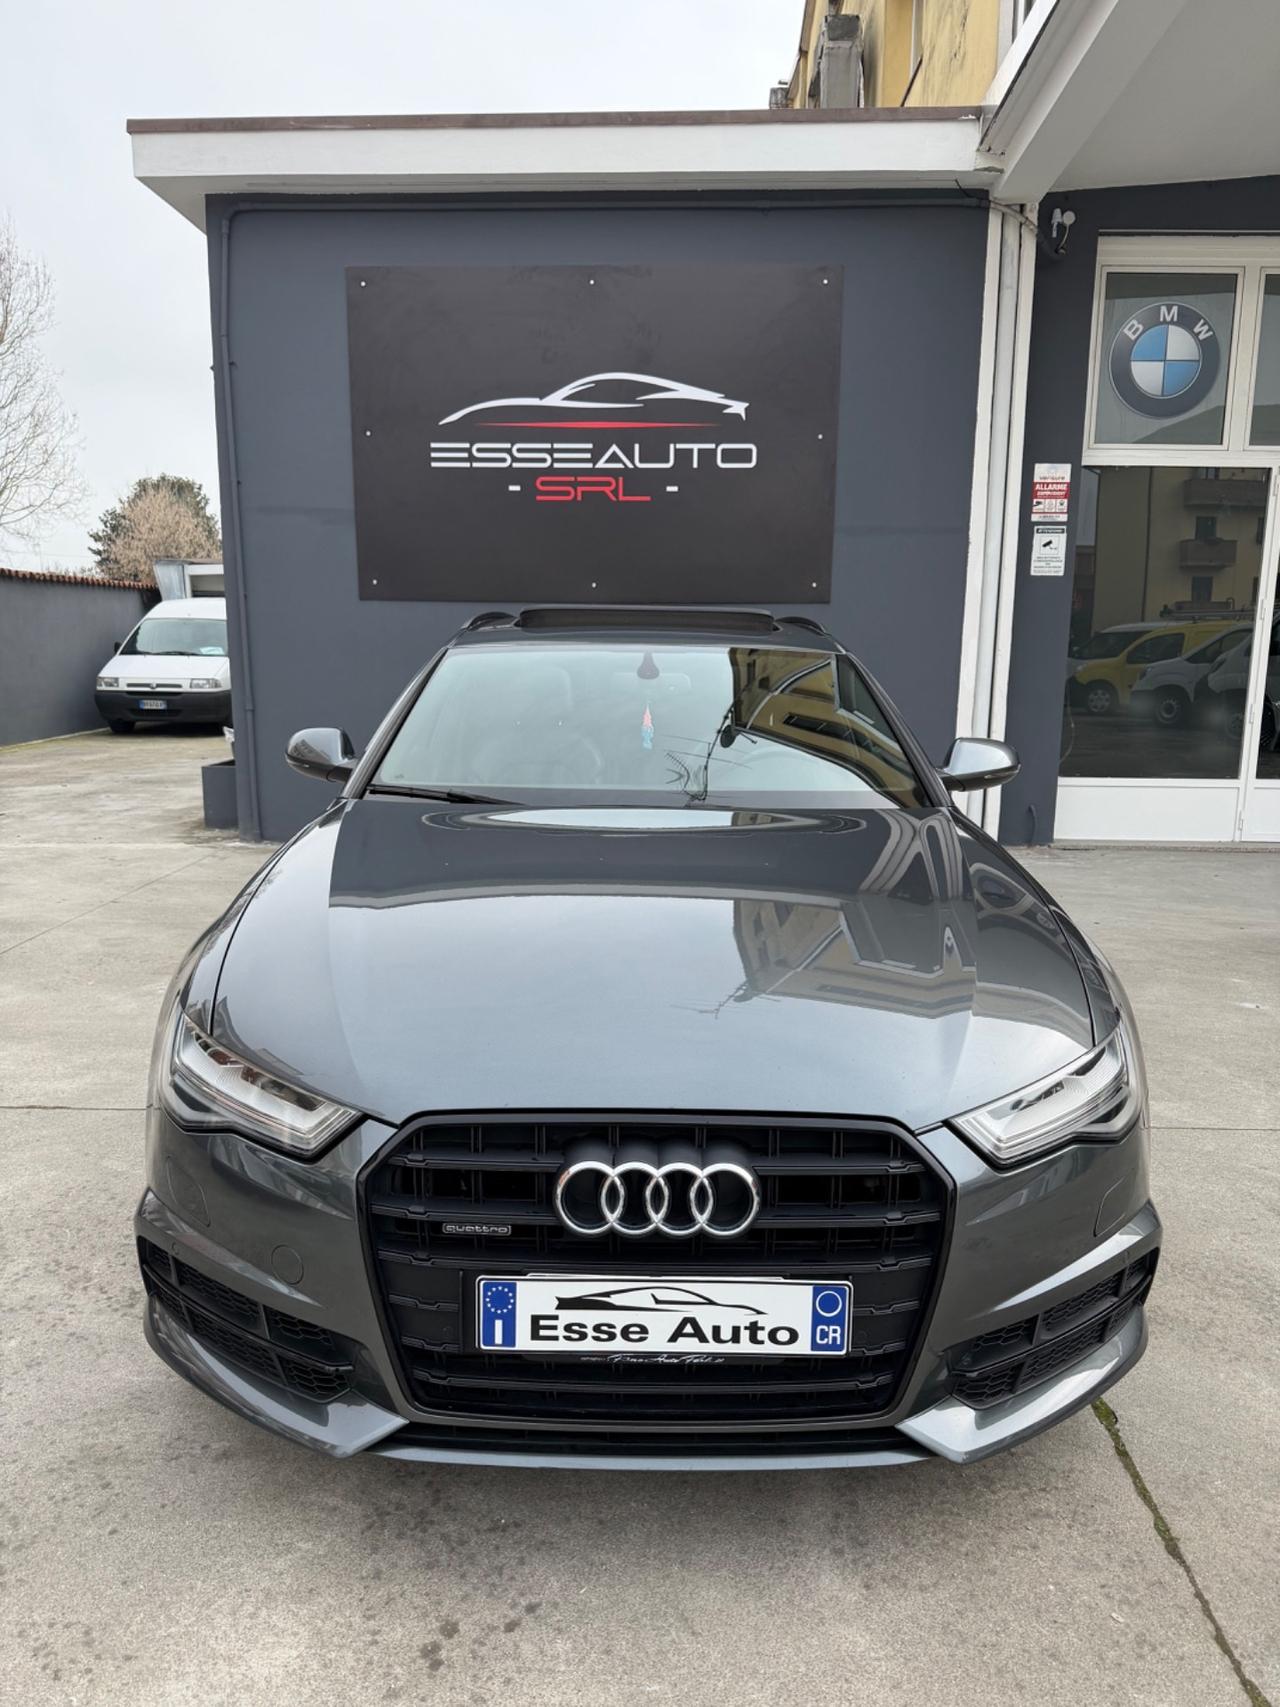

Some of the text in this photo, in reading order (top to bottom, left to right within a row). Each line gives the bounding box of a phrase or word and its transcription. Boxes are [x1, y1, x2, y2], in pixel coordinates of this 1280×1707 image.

[1123, 305, 1213, 341] BMW
[430, 442, 757, 469] ESSEAUTO
[536, 476, 651, 501] SRL
[446, 1225, 508, 1233] quattro
[530, 1314, 649, 1342] Esse
[666, 1316, 800, 1346] Auto
[816, 1325, 841, 1345] CR
